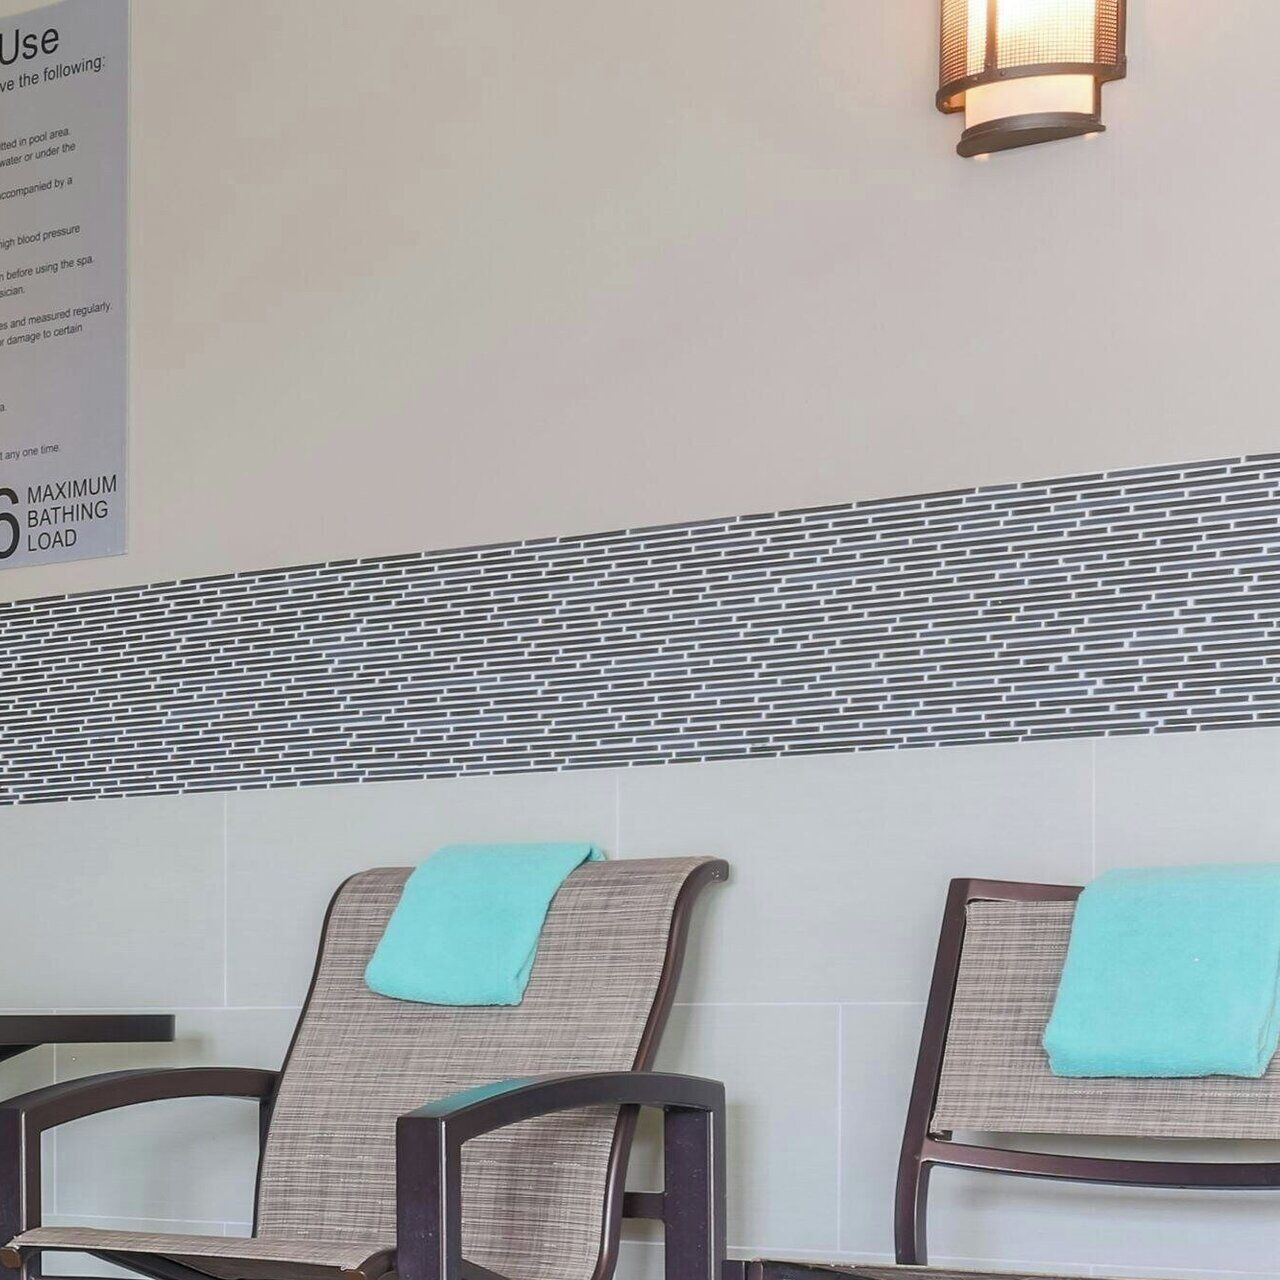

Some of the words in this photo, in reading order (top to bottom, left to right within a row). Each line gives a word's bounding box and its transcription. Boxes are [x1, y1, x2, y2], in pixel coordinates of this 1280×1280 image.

[19, 73, 38, 87] the
[43, 56, 104, 81] following:
[27, 474, 116, 504] MAXIMUM
[27, 499, 108, 528] BATHING
[27, 528, 77, 551] LOAD
